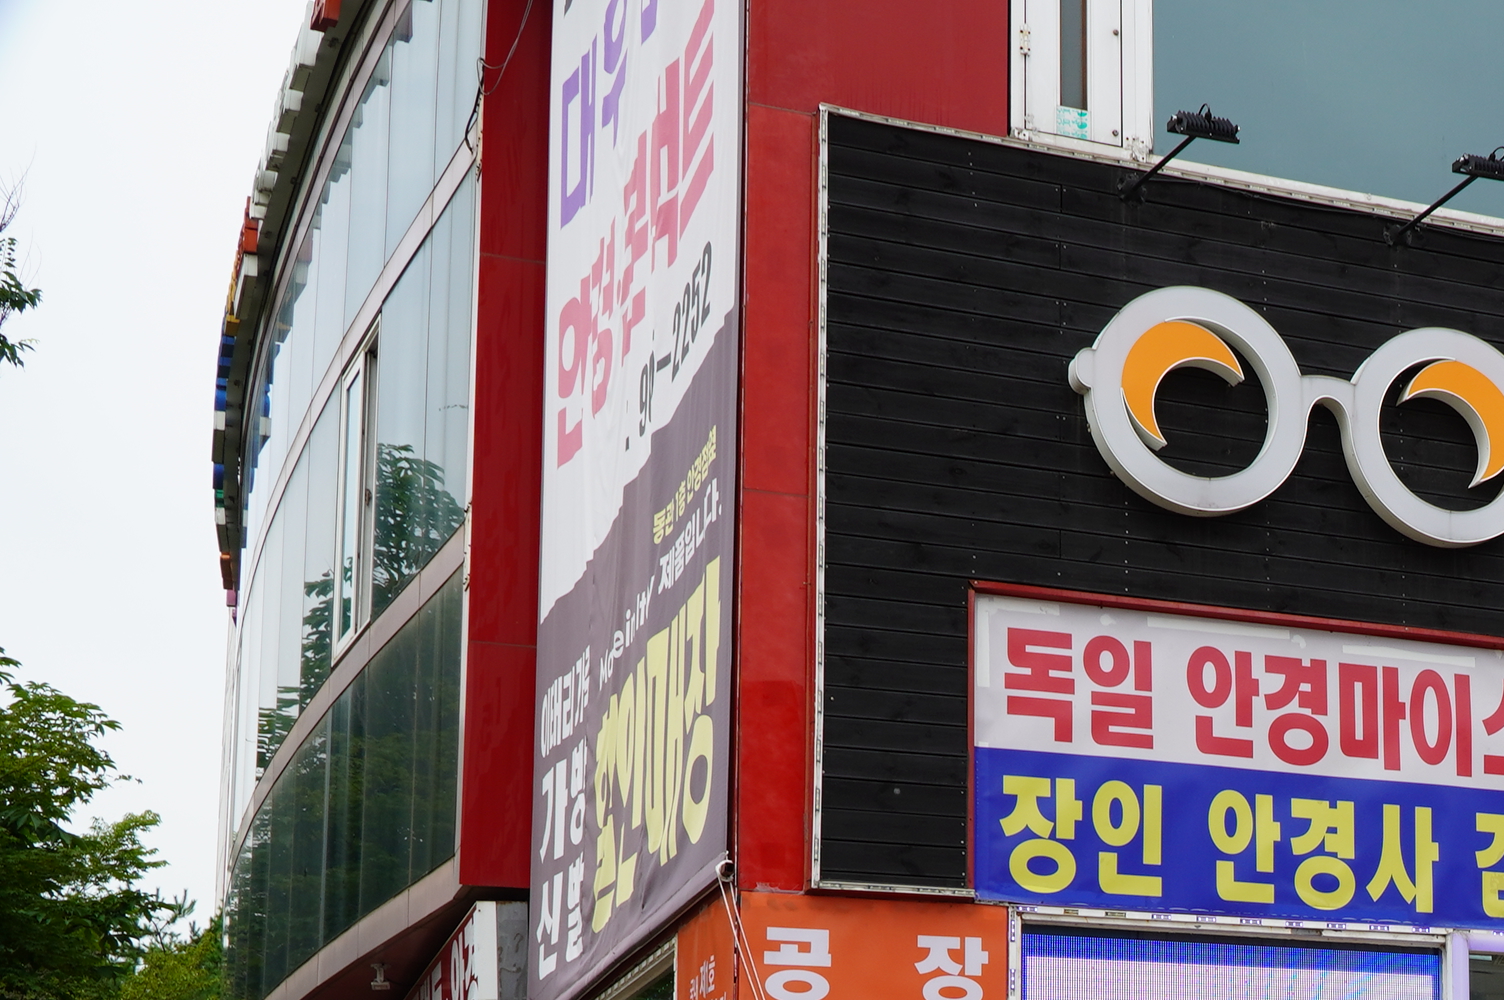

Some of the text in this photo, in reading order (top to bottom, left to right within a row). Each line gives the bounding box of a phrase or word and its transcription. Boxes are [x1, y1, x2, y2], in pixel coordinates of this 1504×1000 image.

[592, 555, 722, 934] 할인매장
[1003, 626, 1154, 750] 독일
[539, 735, 588, 864] 가방
[999, 774, 1163, 897] 장인
[1207, 789, 1440, 913] 안경사
